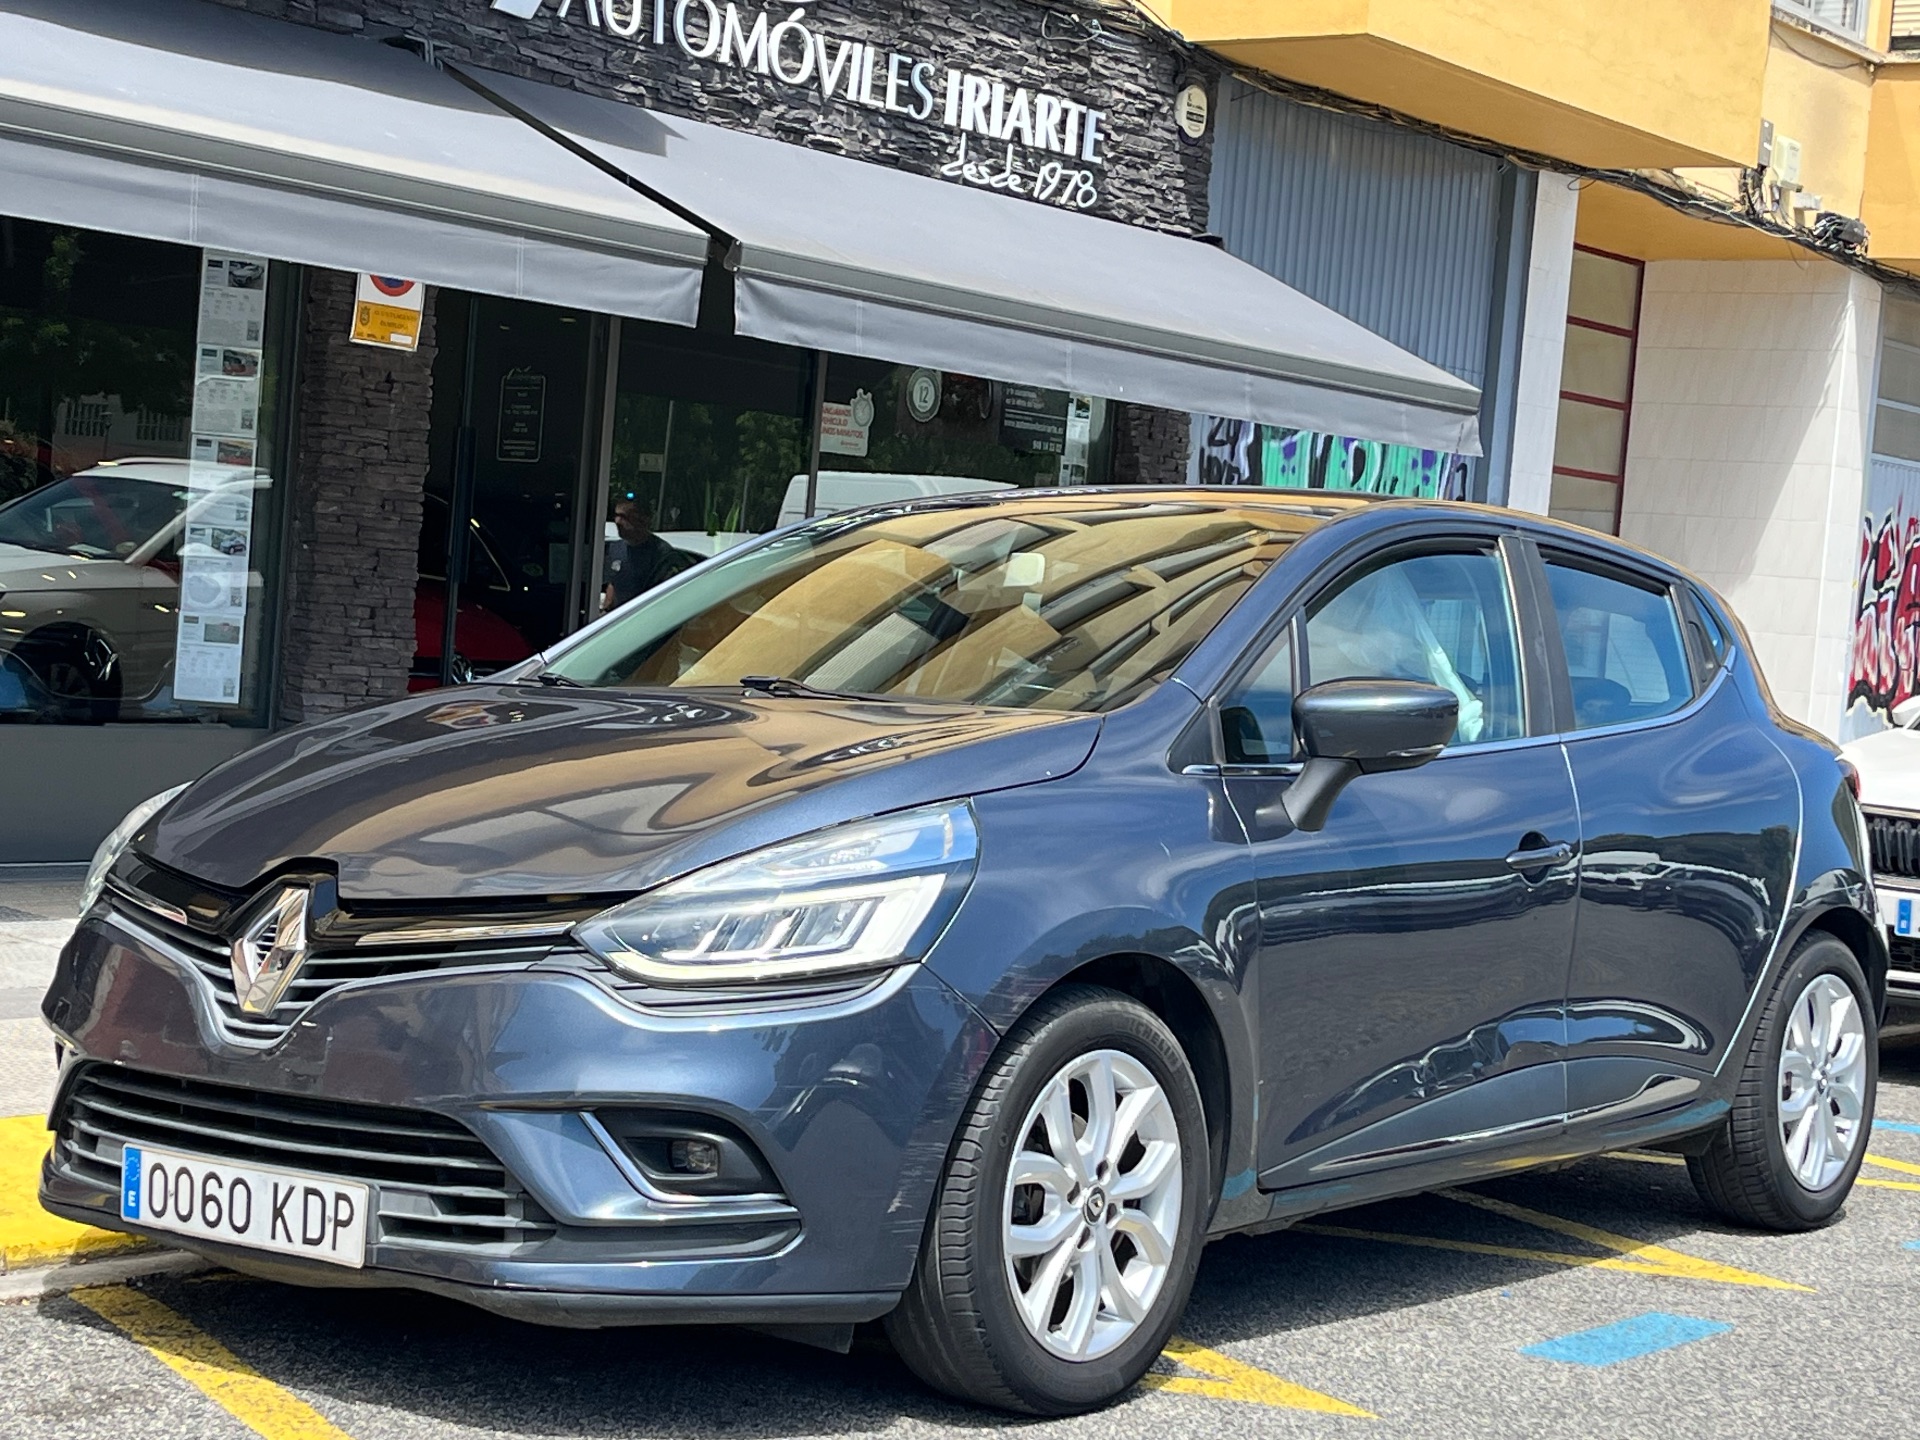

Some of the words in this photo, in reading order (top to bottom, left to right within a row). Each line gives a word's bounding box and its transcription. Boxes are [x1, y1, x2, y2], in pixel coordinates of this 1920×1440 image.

[943, 68, 1106, 165] IRIARTE
[940, 131, 1025, 193] desde
[1033, 161, 1098, 208] 1978
[127, 1190, 137, 1207] E
[148, 1162, 252, 1235] 0060
[270, 1182, 355, 1251] KDP
